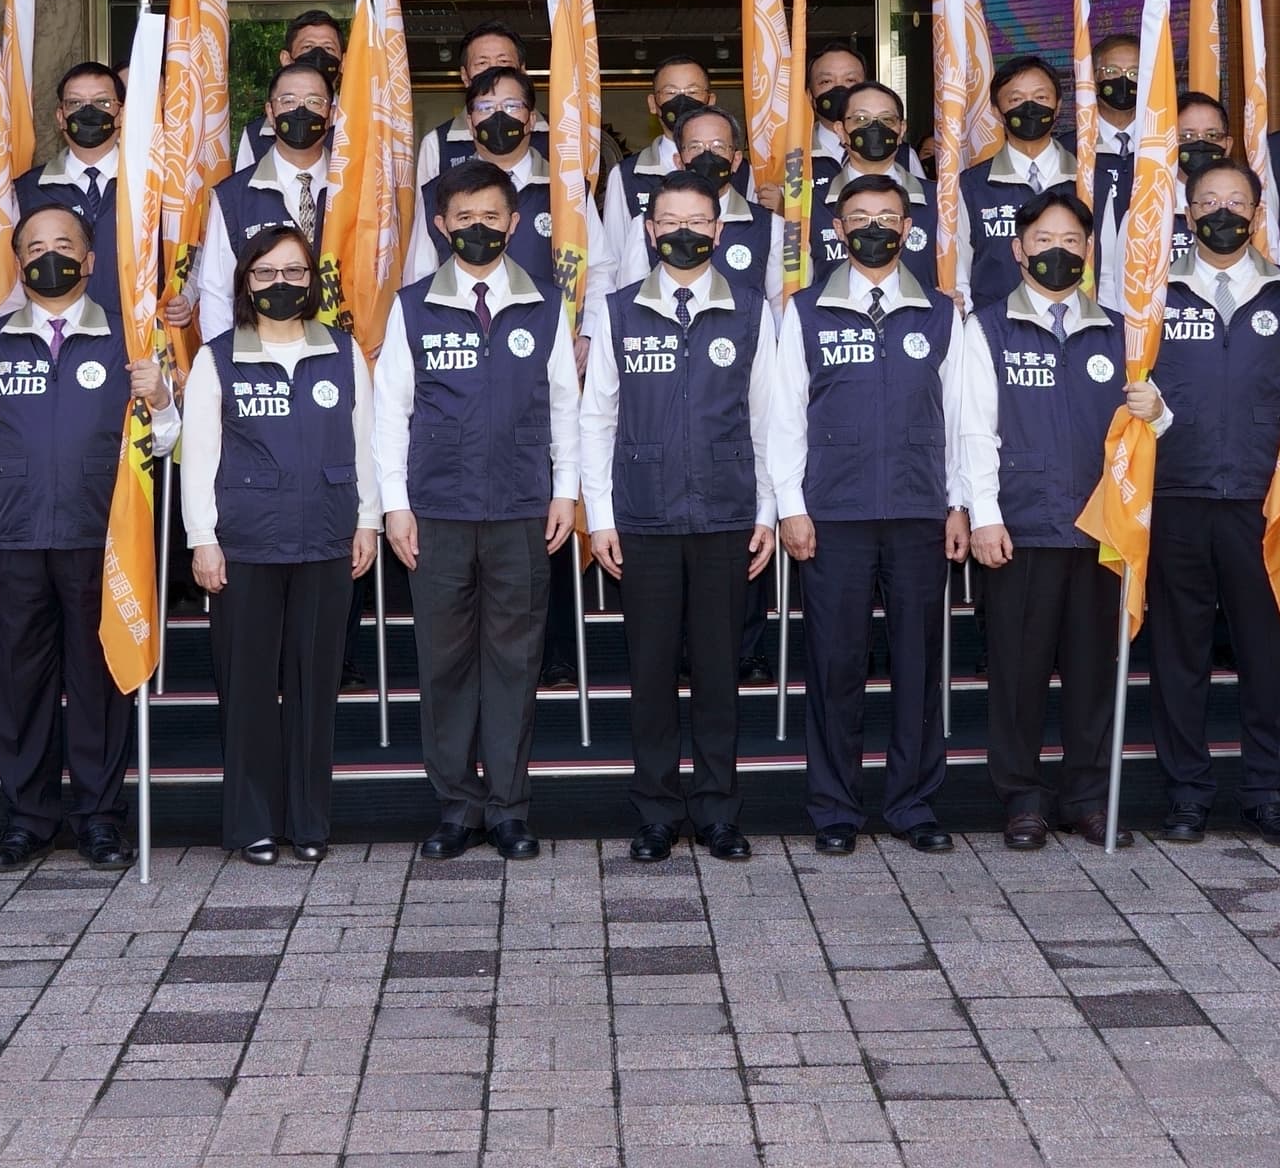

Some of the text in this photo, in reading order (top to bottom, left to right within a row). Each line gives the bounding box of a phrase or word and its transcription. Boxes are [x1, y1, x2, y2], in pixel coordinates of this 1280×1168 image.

[983, 220, 1017, 237] MJI
[1163, 307, 1215, 322] 調查局
[818, 328, 875, 344] 調查局
[1164, 322, 1214, 340] MJIB
[422, 332, 479, 349] 調查局
[623, 335, 678, 351] 調查局
[426, 350, 477, 370] MJIB
[624, 353, 675, 373] MJIB
[821, 345, 874, 366] MJIB
[1003, 350, 1056, 367] 調查局
[1006, 367, 1055, 386] MJIB
[232, 381, 290, 397] 調查局
[236, 398, 290, 417] MJIB
